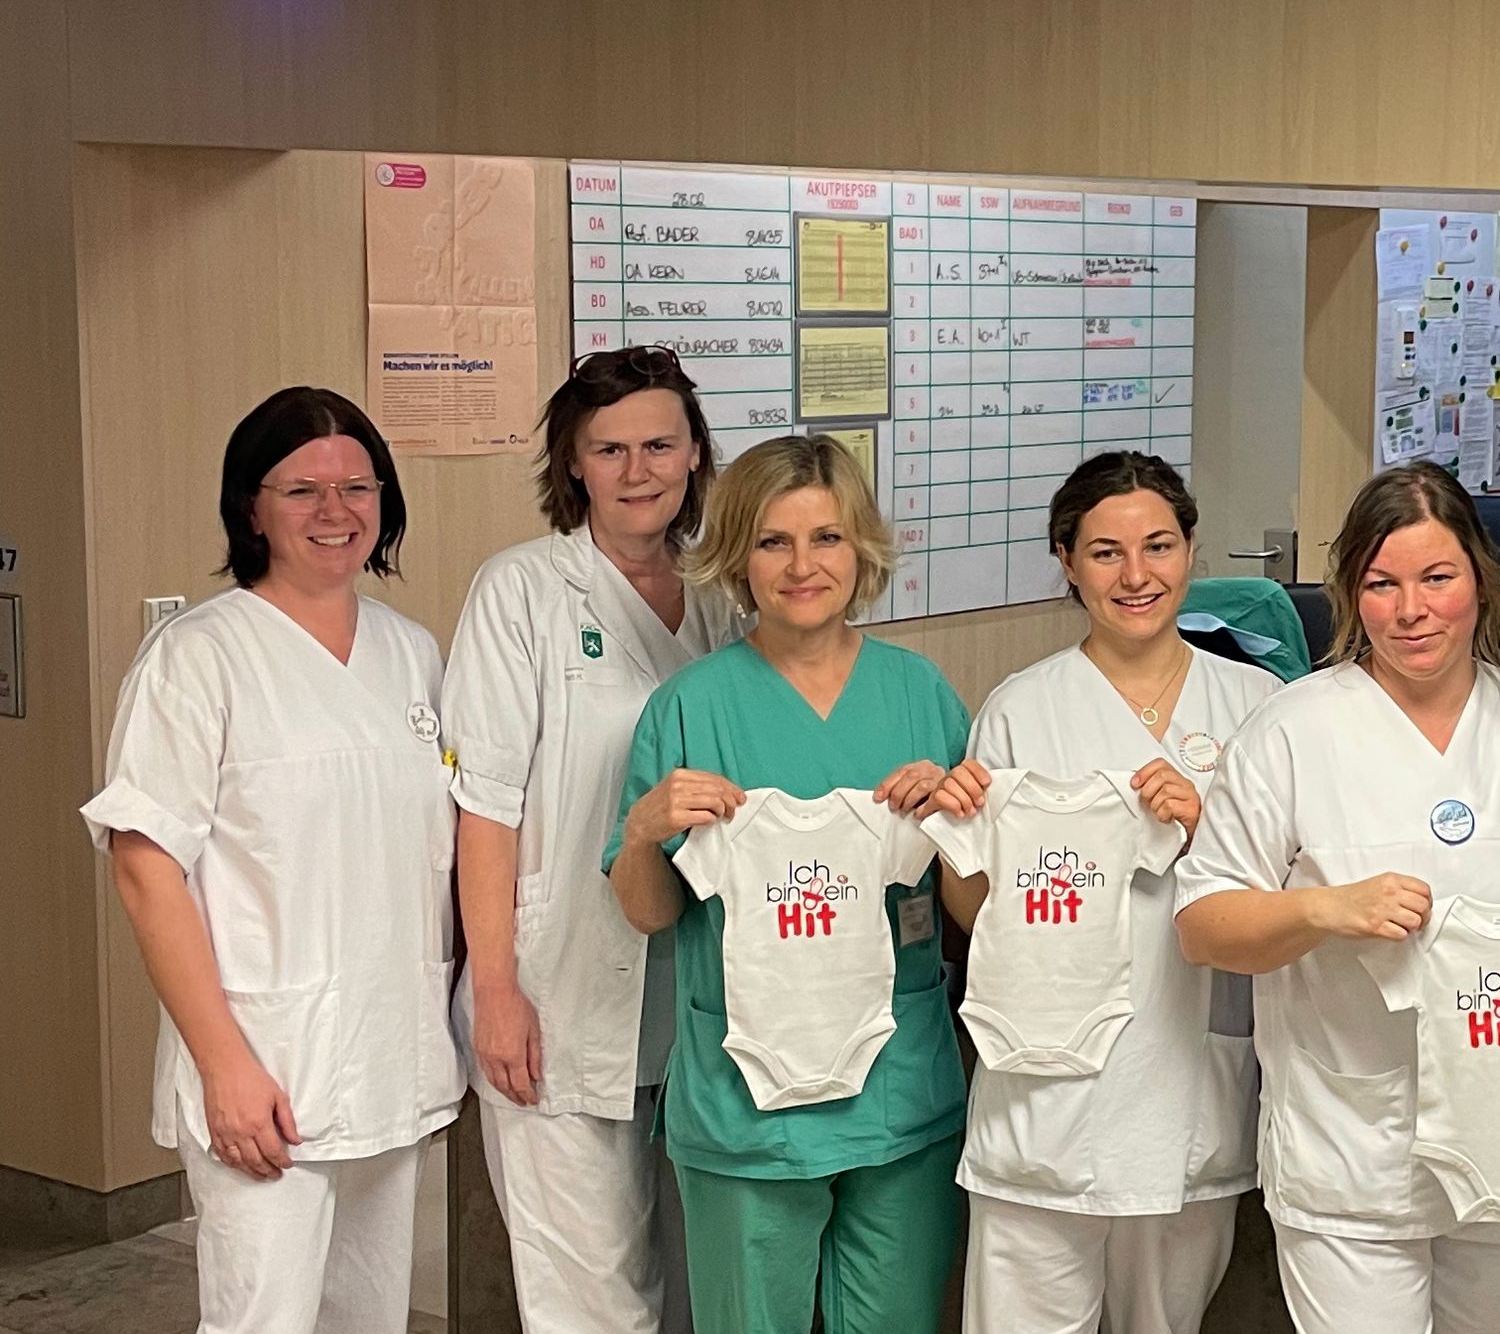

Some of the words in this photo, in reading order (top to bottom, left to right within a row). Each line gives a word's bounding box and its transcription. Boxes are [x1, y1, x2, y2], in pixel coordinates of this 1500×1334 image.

[576, 177, 616, 192] DATUM
[806, 182, 877, 198] AKUTPIEPSER
[937, 195, 962, 207] NAME
[980, 196, 999, 208] SSW
[656, 225, 700, 243] BADER
[899, 227, 917, 240] BAD
[590, 256, 605, 269] HD
[648, 265, 685, 280] KERN
[591, 294, 606, 308] BD
[909, 296, 915, 308] 2
[591, 333, 607, 347] KH
[423, 361, 437, 371] wir
[440, 362, 450, 370] es
[452, 360, 493, 373] möglich!
[909, 363, 915, 375] 4
[909, 397, 915, 409] 5
[909, 431, 915, 443] 6
[909, 464, 915, 475] 7
[917, 530, 923, 541] 2
[1038, 845, 1079, 870] Ich
[789, 859, 830, 884] Ich
[1016, 867, 1049, 888] bin
[1072, 867, 1105, 888] ein
[766, 882, 801, 902] bin
[824, 880, 858, 901] ein
[1026, 888, 1083, 924] Hit
[778, 903, 837, 939] Hit
[1457, 989, 1491, 1010] bin
